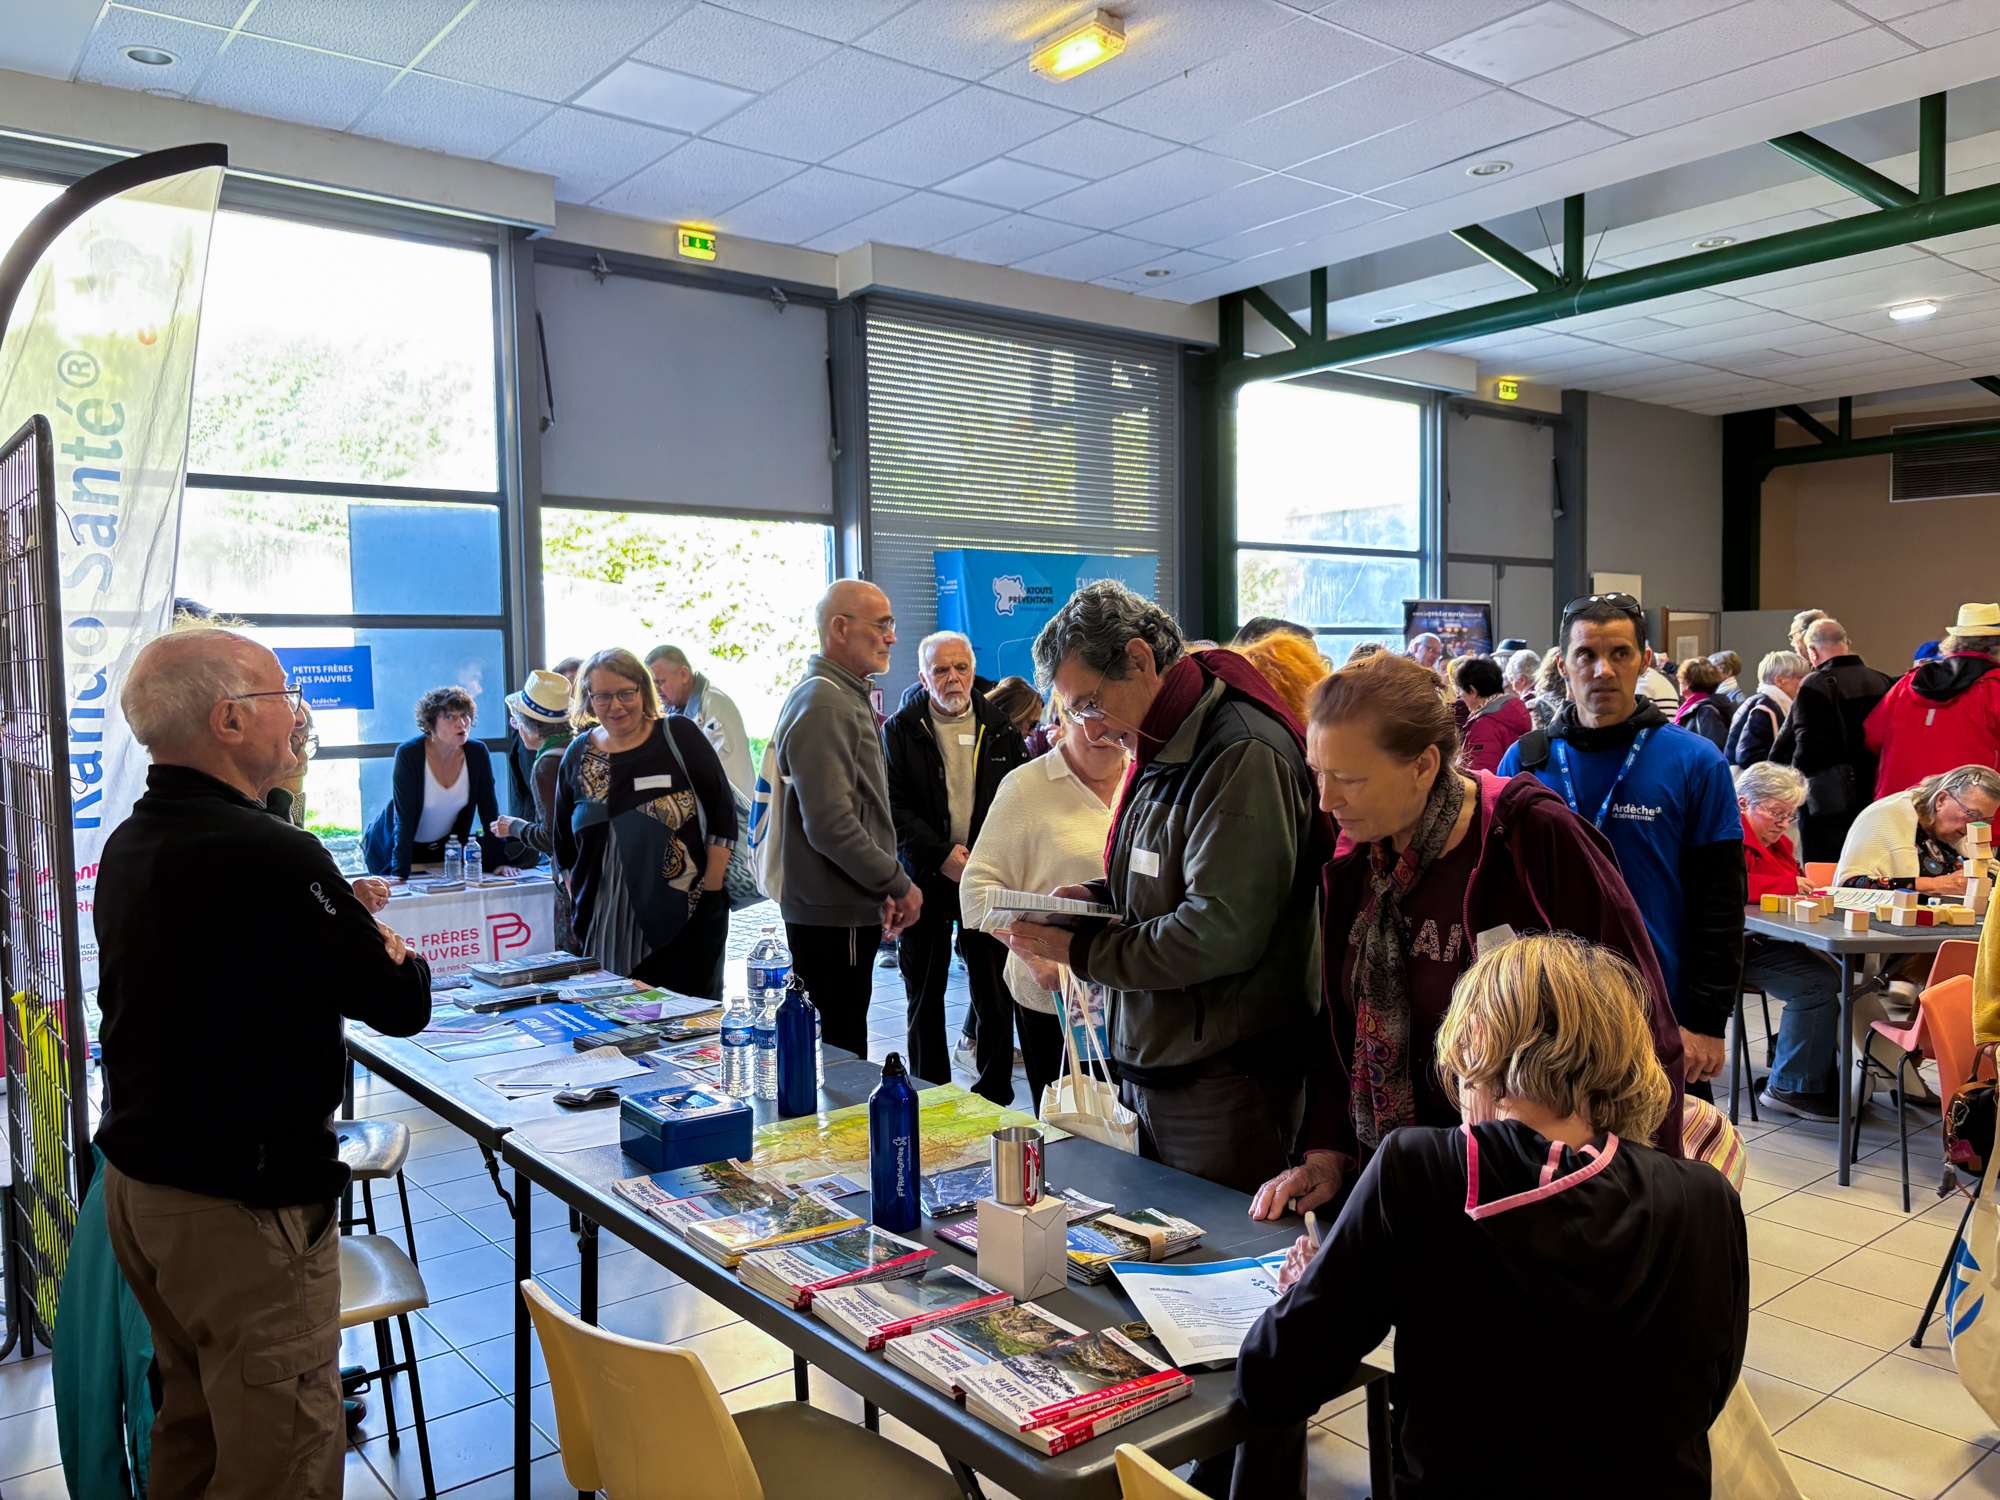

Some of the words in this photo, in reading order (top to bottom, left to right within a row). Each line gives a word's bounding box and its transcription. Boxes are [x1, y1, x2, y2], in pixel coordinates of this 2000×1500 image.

[1026, 587, 1053, 595] ATOUTS
[1008, 595, 1053, 604] PRÉVENTION
[293, 665, 322, 674] PETITS
[323, 664, 353, 673] FRÈRES
[295, 676, 312, 684] DES
[314, 675, 352, 683] PAUVRES
[1612, 803, 1655, 816] Ardèche
[1618, 813, 1655, 821] DÉPARTEMENT
[422, 928, 479, 947] FRÈRES
[421, 943, 480, 962] AUVRES
[838, 1296, 862, 1312] central
[857, 1311, 880, 1326] Massif
[976, 1376, 1001, 1393] gorges
[990, 1377, 1023, 1397] Loire
[1000, 1396, 1025, 1412] Source
[1016, 1394, 1031, 1402] la
[1024, 1400, 1040, 1408] de
[1075, 1393, 1102, 1405] Grande
[1035, 1400, 1076, 1417] Randonnée
[1060, 1411, 1098, 1430] Randonnée
